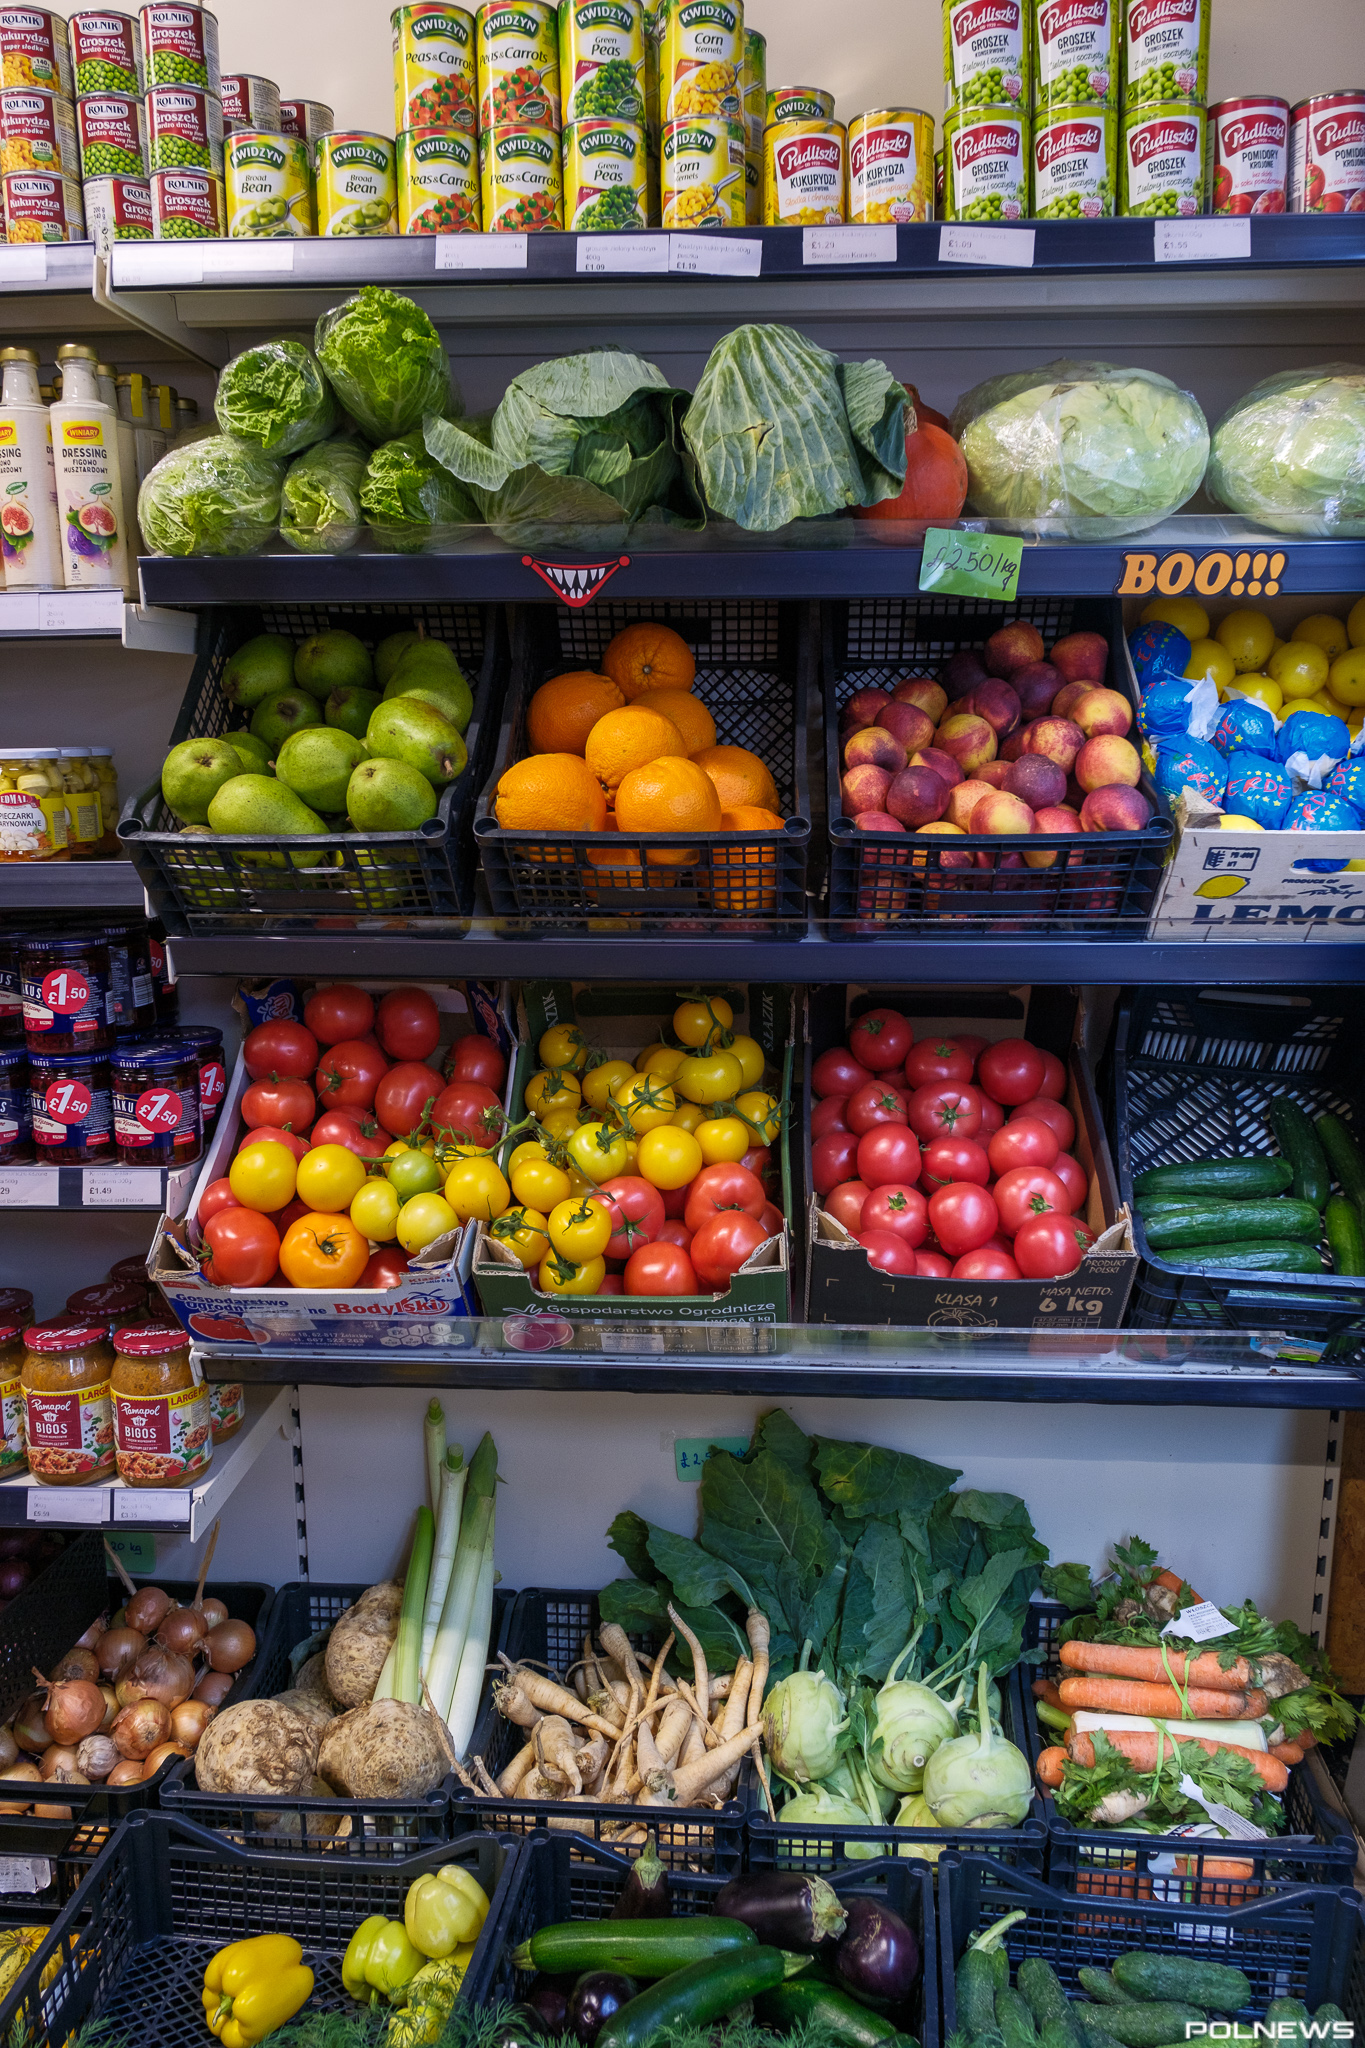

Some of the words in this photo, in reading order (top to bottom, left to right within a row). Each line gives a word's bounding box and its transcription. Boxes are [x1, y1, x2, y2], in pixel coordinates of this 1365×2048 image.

[2, 15, 40, 26] ROLNIK
[152, 12, 190, 23] ROLNIK
[577, 6, 631, 26] KWIDZYN
[682, 5, 734, 28] KWIDZYN
[956, 6, 1017, 36] Pudliszki
[1043, 1, 1104, 33] Pudliszki
[1131, 0, 1193, 32] Pudliszki
[82, 21, 119, 31] ROLNIK
[413, 18, 467, 41] KWIDZYN
[484, 14, 537, 36] KWIDZYN
[80, 38, 126, 49] Groszek
[173, 39, 196, 47] drobny
[595, 36, 617, 44] Green
[694, 33, 723, 46] Corn
[972, 35, 1009, 51] GROSZEK
[1058, 31, 1096, 49] GROSZEK
[1145, 28, 1184, 47] GROSZEK
[103, 47, 126, 56] drobny
[591, 45, 621, 57] Peas
[695, 46, 722, 55] Kernels
[5, 100, 41, 109] ROLNIK
[157, 97, 192, 107] ROLNIK
[88, 107, 124, 115] ROLNIK
[1, 116, 50, 128] Kukurydza
[86, 121, 131, 132] Groszek
[88, 130, 107, 138] bardzo
[109, 130, 132, 138] drobny
[1225, 122, 1285, 148] Pudliszki
[498, 139, 551, 159] KWIDZYN
[581, 134, 634, 155] KWIDZYN
[957, 132, 1016, 161] Pudliszki
[1038, 129, 1098, 162] Pudliszki
[1132, 128, 1195, 157] Pudliszki
[231, 145, 283, 165] KWIDZYN
[333, 147, 387, 168] KWIDZYN
[416, 141, 469, 162] KWIDZYN
[780, 145, 838, 171] Pudliszki
[852, 135, 907, 168] Pudliszki
[1242, 150, 1278, 162] POMIDORY
[598, 162, 620, 170] Green
[674, 161, 700, 173] Corn
[972, 161, 1009, 176] GROSZEK
[1051, 158, 1088, 177] GROSZEK
[1148, 157, 1186, 173] GROSZEK
[1250, 161, 1273, 169] KROJONE
[245, 174, 267, 182] Broad
[350, 174, 373, 183] Broad
[593, 169, 623, 182] Peas
[790, 174, 836, 188] KUKURYDZA
[858, 163, 905, 185] KUKURYDZA
[14, 183, 50, 191] ROLNIK
[168, 180, 205, 191] ROLNIK
[241, 182, 272, 194] Bean
[345, 181, 377, 195] Bean
[10, 198, 60, 209] Kukurydza
[165, 195, 210, 208] Groszek
[32, 209, 53, 217] słodka
[125, 213, 147, 221] bardzo
[189, 206, 211, 215] drobny
[811, 241, 835, 249] £1.29
[676, 262, 697, 270] £1.19
[69, 429, 98, 438] WINIARY
[62, 448, 107, 459] DRESSING
[1117, 552, 1286, 597] BOO!!!
[1227, 776, 1291, 800] ERDE
[48, 973, 87, 1005] £1.50
[201, 1067, 224, 1096] £1.50
[49, 1084, 87, 1114] £1.50
[138, 1093, 177, 1125] £1.50
[89, 1187, 112, 1195] £1.49
[1085, 1259, 1127, 1267] PRODUKT
[1088, 1266, 1120, 1274] POLSKI
[1040, 1287, 1072, 1296] MASA
[1074, 1286, 1113, 1296] NETTO:
[175, 1293, 289, 1308] Gospodarstwo
[333, 1299, 438, 1315] Bodylski
[935, 1293, 982, 1306] KLASA
[988, 1295, 998, 1307] 1
[1039, 1298, 1057, 1312] 6
[1066, 1297, 1104, 1316] kg
[547, 1305, 674, 1316] Gospodarstwo
[679, 1302, 776, 1317] Ogrodnicze
[757, 1314, 771, 1322] kg
[82, 1384, 109, 1401] LARGE
[171, 1390, 198, 1406] LARGE
[31, 1398, 72, 1413] Pamapol
[120, 1402, 160, 1417] Pamapol
[36, 1422, 68, 1435] BIGOS
[125, 1426, 157, 1439] BIGOS
[130, 1542, 142, 1556] kg
